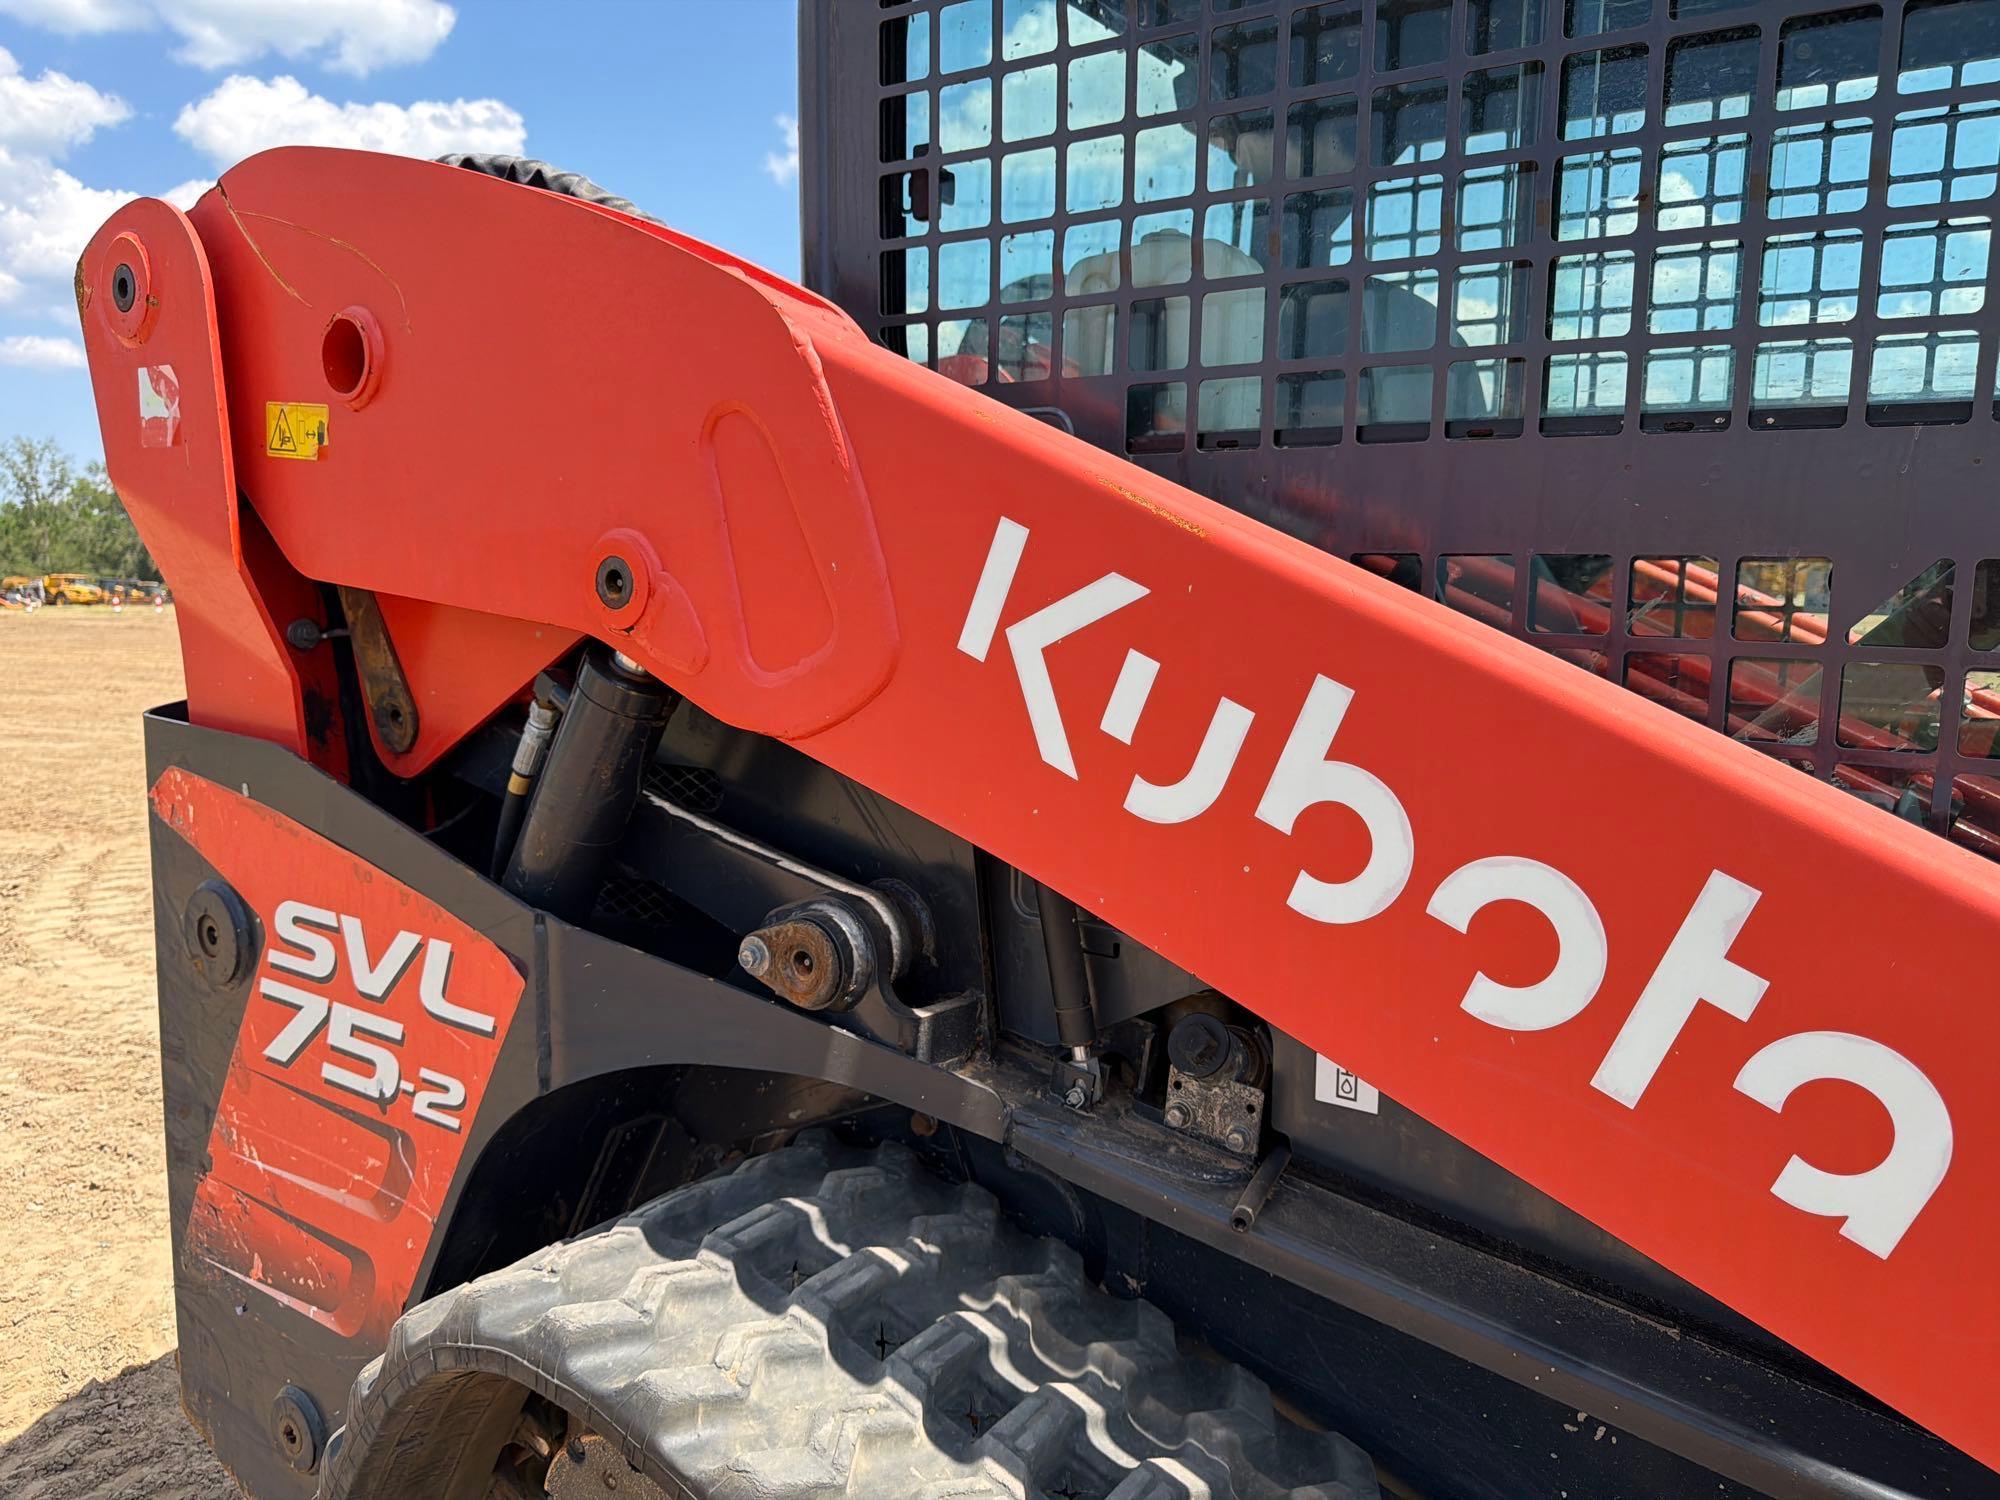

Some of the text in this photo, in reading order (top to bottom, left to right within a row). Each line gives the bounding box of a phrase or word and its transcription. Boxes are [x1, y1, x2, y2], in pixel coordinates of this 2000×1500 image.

[957, 516, 1954, 1260] Kubota
[267, 900, 496, 1037] SVL
[259, 977, 467, 1131] 75-2
